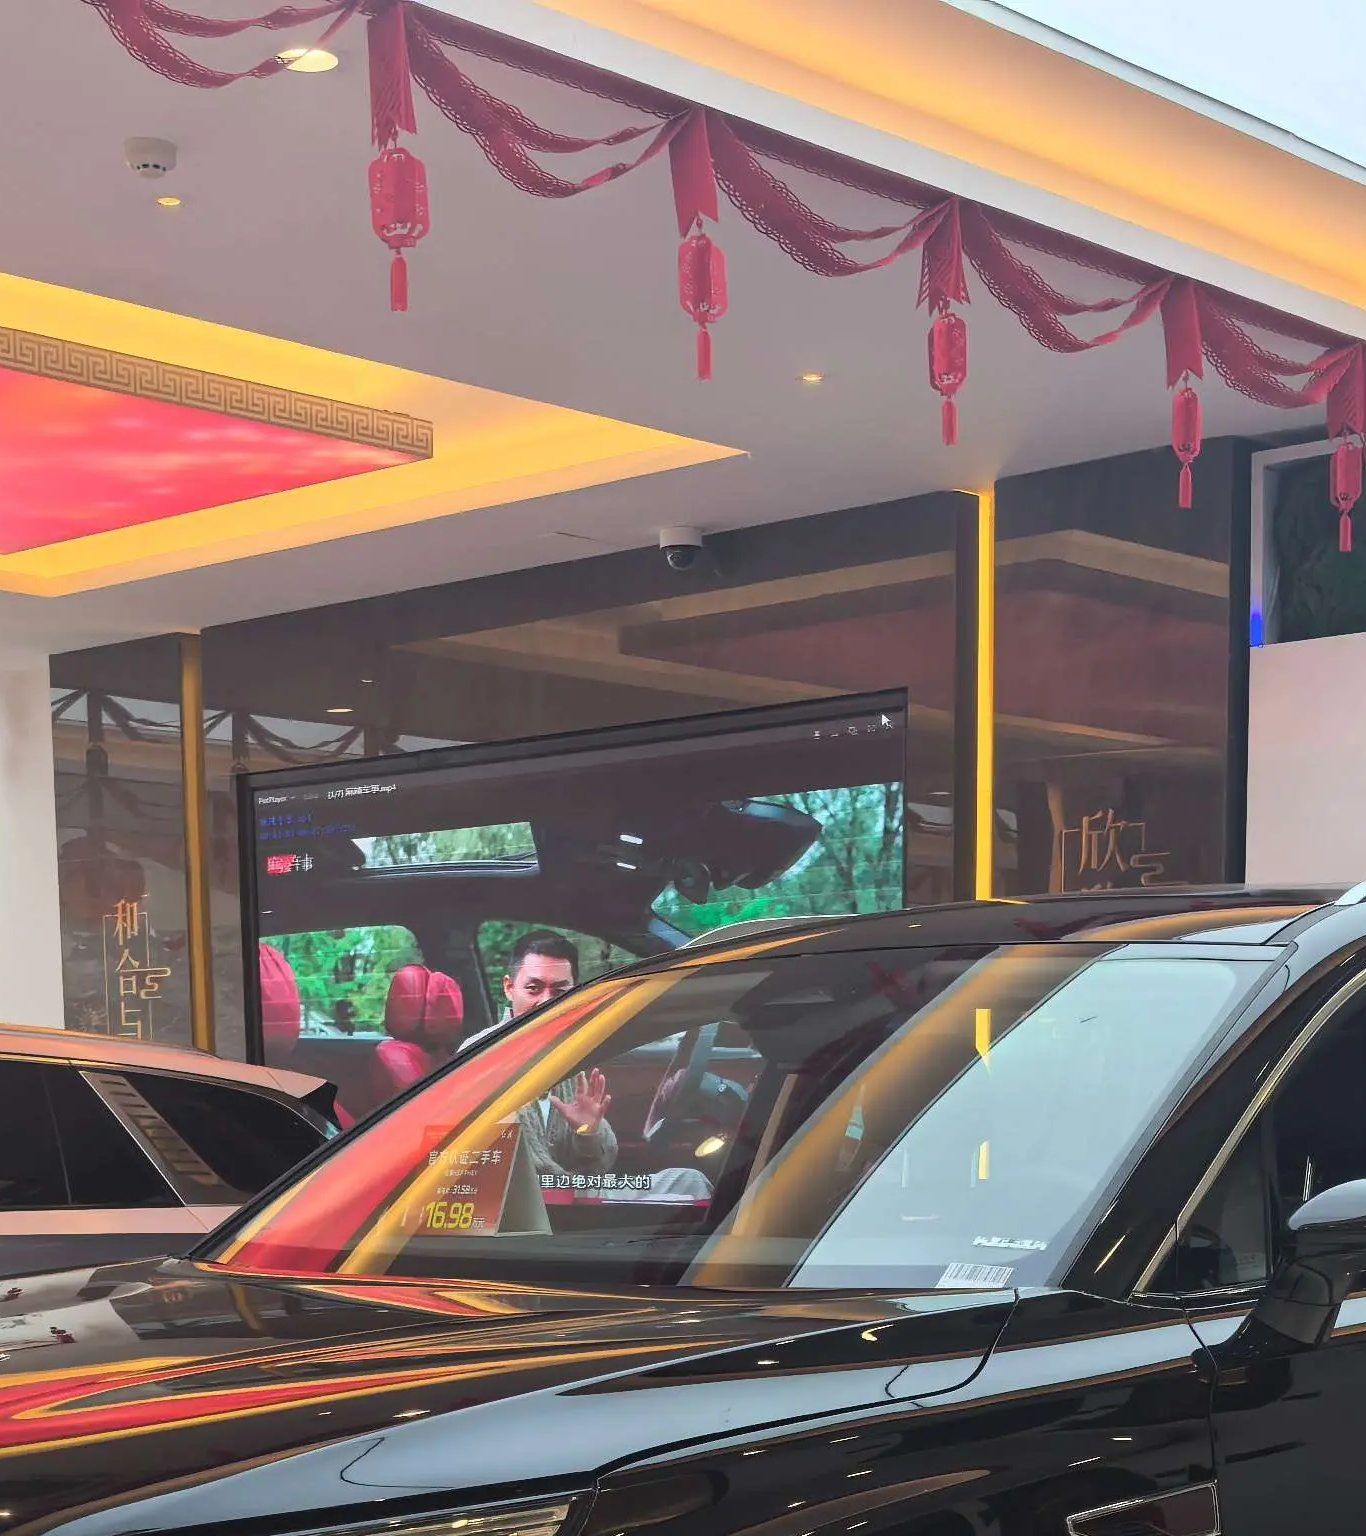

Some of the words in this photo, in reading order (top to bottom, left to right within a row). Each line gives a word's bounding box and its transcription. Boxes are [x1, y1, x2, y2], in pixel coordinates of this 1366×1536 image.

[1077, 807, 1129, 889] 欣
[536, 1173, 651, 1190] 里边绝对最大的
[425, 1201, 475, 1229] 16.98
